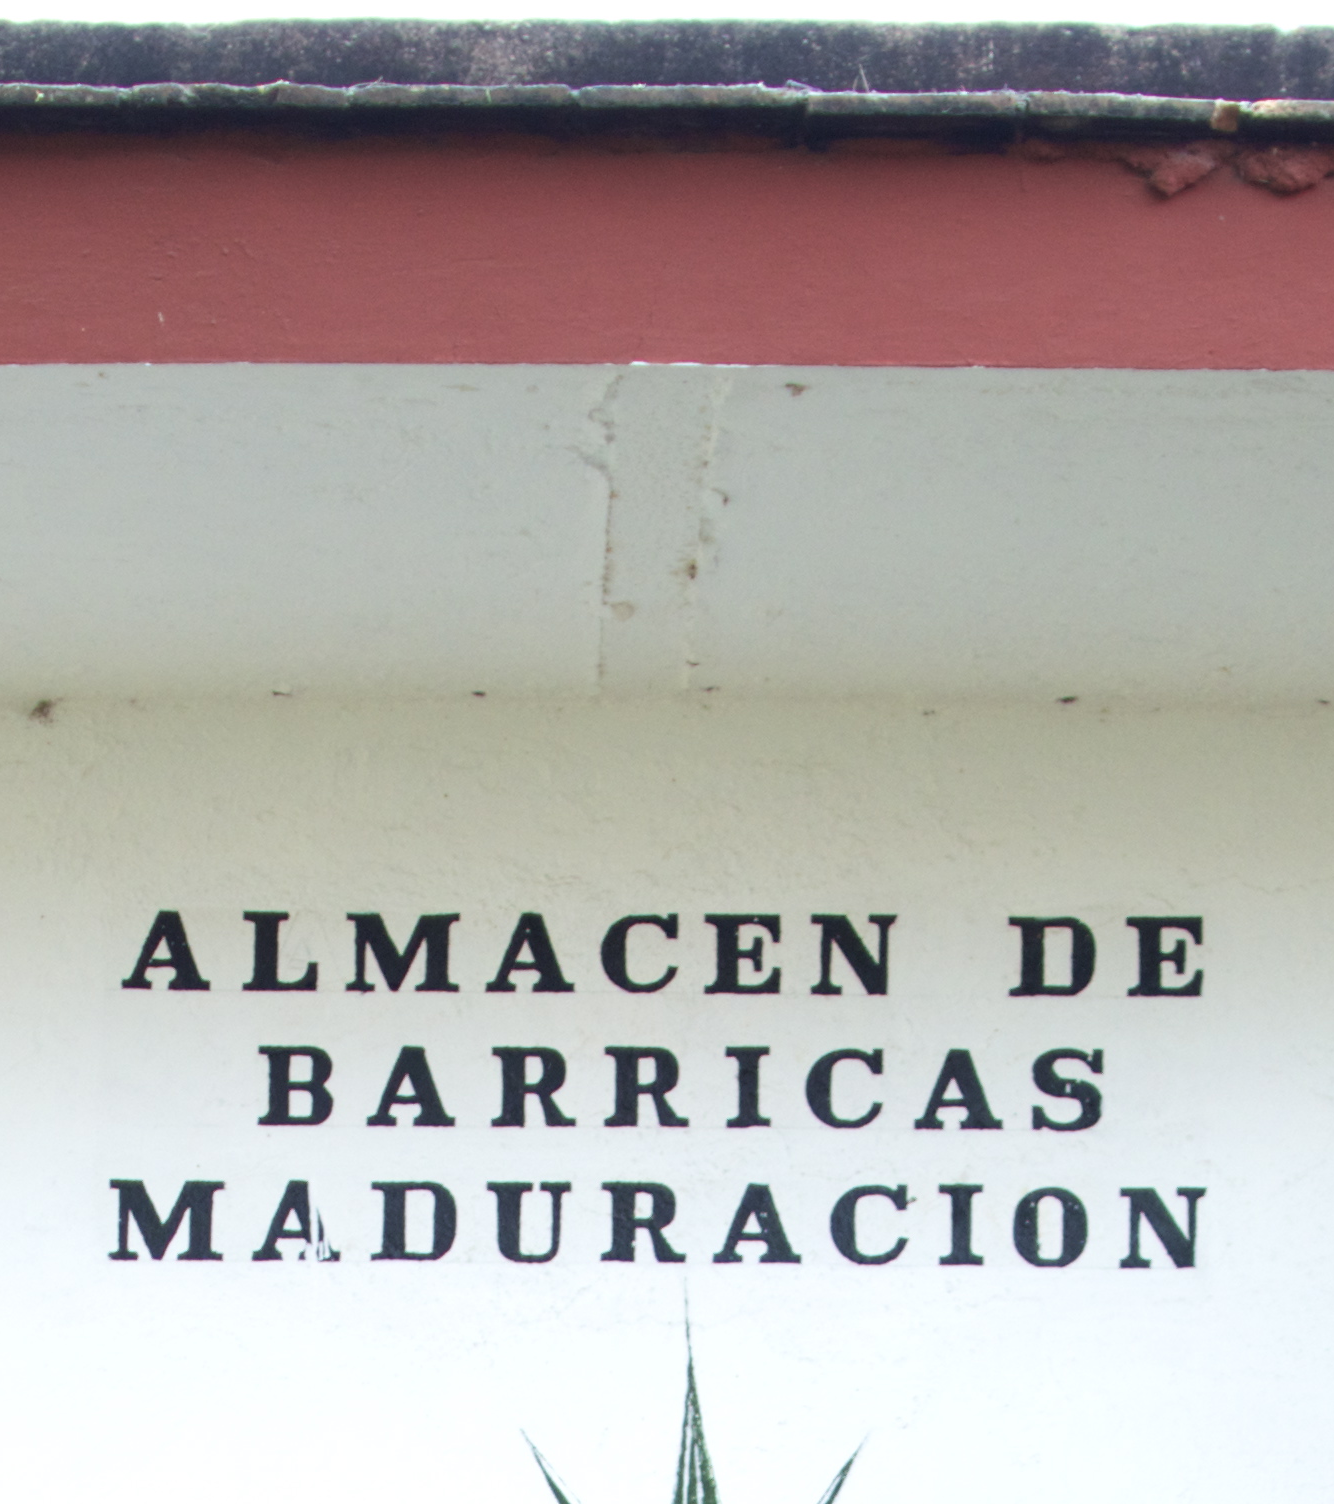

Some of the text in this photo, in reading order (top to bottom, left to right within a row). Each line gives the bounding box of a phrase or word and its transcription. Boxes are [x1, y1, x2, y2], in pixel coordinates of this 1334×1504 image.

[121, 910, 1204, 997] ALMACEN DE
[258, 1046, 1105, 1132] BARRICAS
[109, 1179, 1207, 1269] MADURACION
